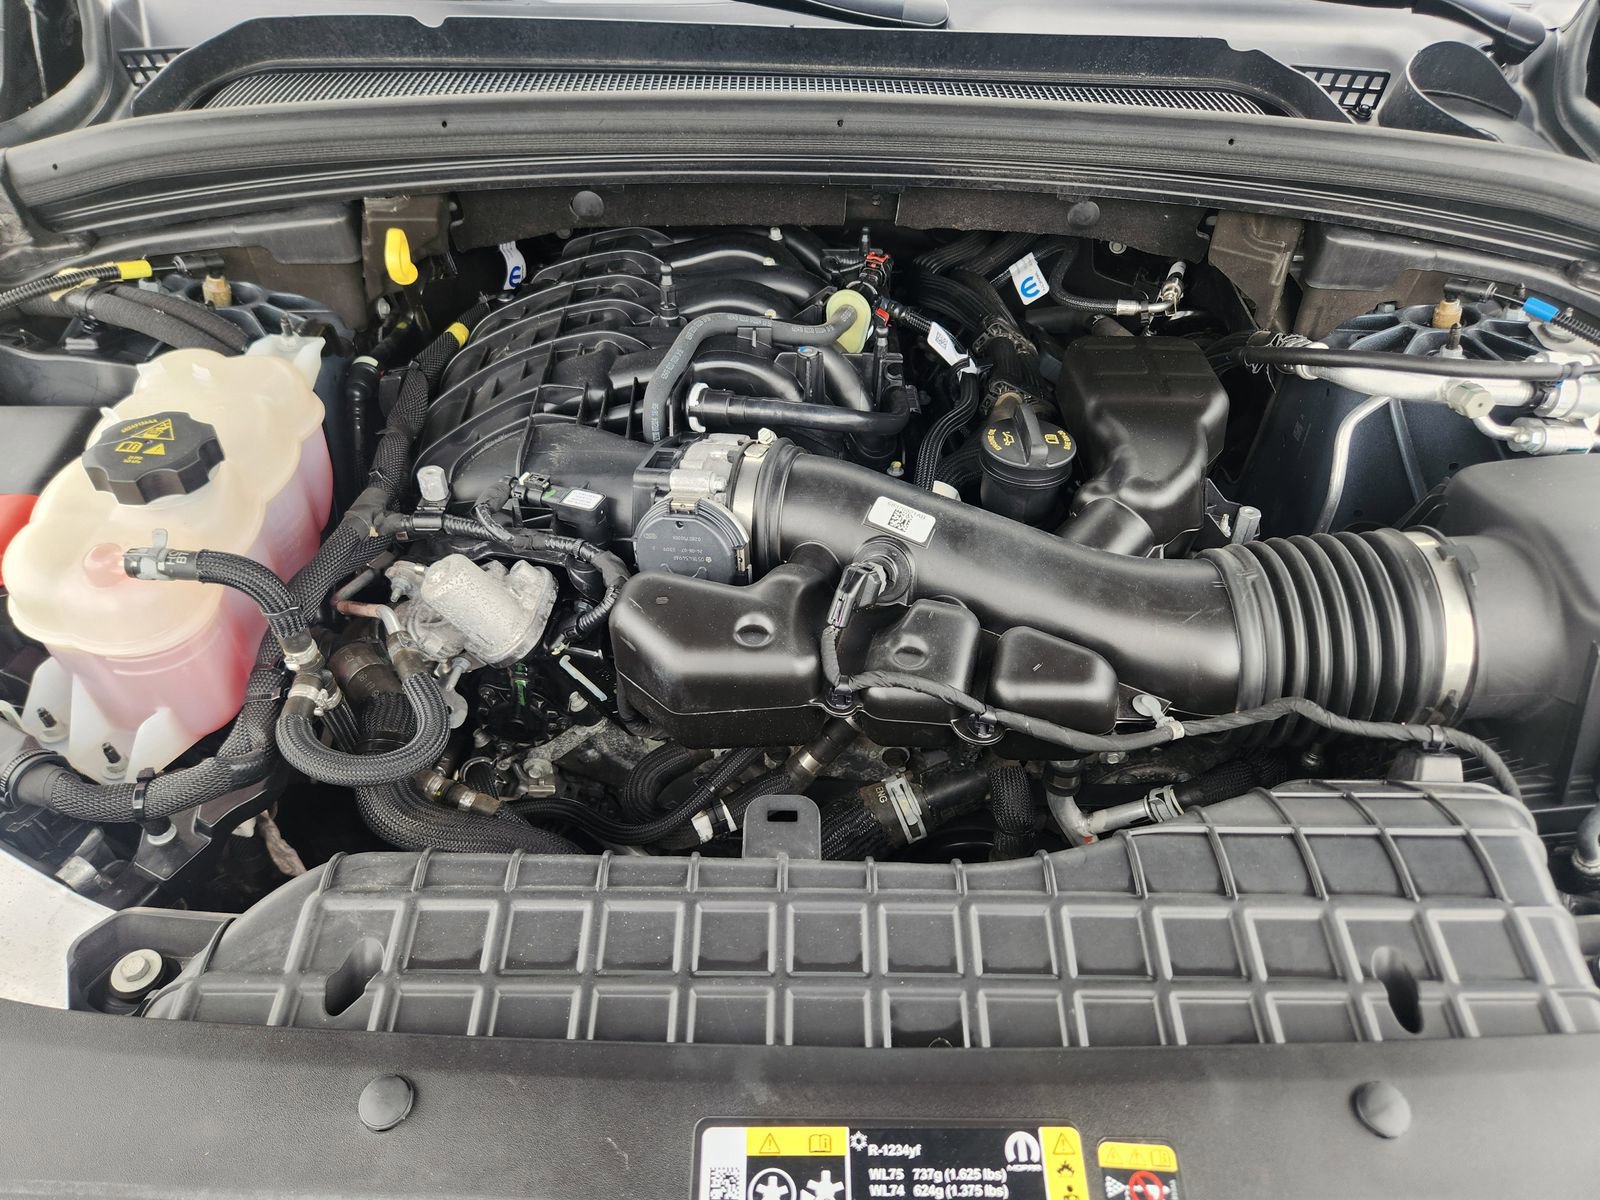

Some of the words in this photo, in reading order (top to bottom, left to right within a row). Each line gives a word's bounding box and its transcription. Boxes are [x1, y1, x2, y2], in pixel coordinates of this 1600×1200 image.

[875, 786, 888, 803] ENG
[867, 1143, 922, 1159] R-1234yf
[868, 1168, 905, 1181] WL75
[912, 1168, 943, 1183] 737g
[944, 1168, 982, 1183] (1.625
[982, 1168, 1008, 1183] lbs)
[868, 1184, 906, 1197] WL74
[912, 1184, 944, 1200] 624g
[945, 1184, 984, 1200] (1.375
[984, 1184, 1009, 1200] lbs)
